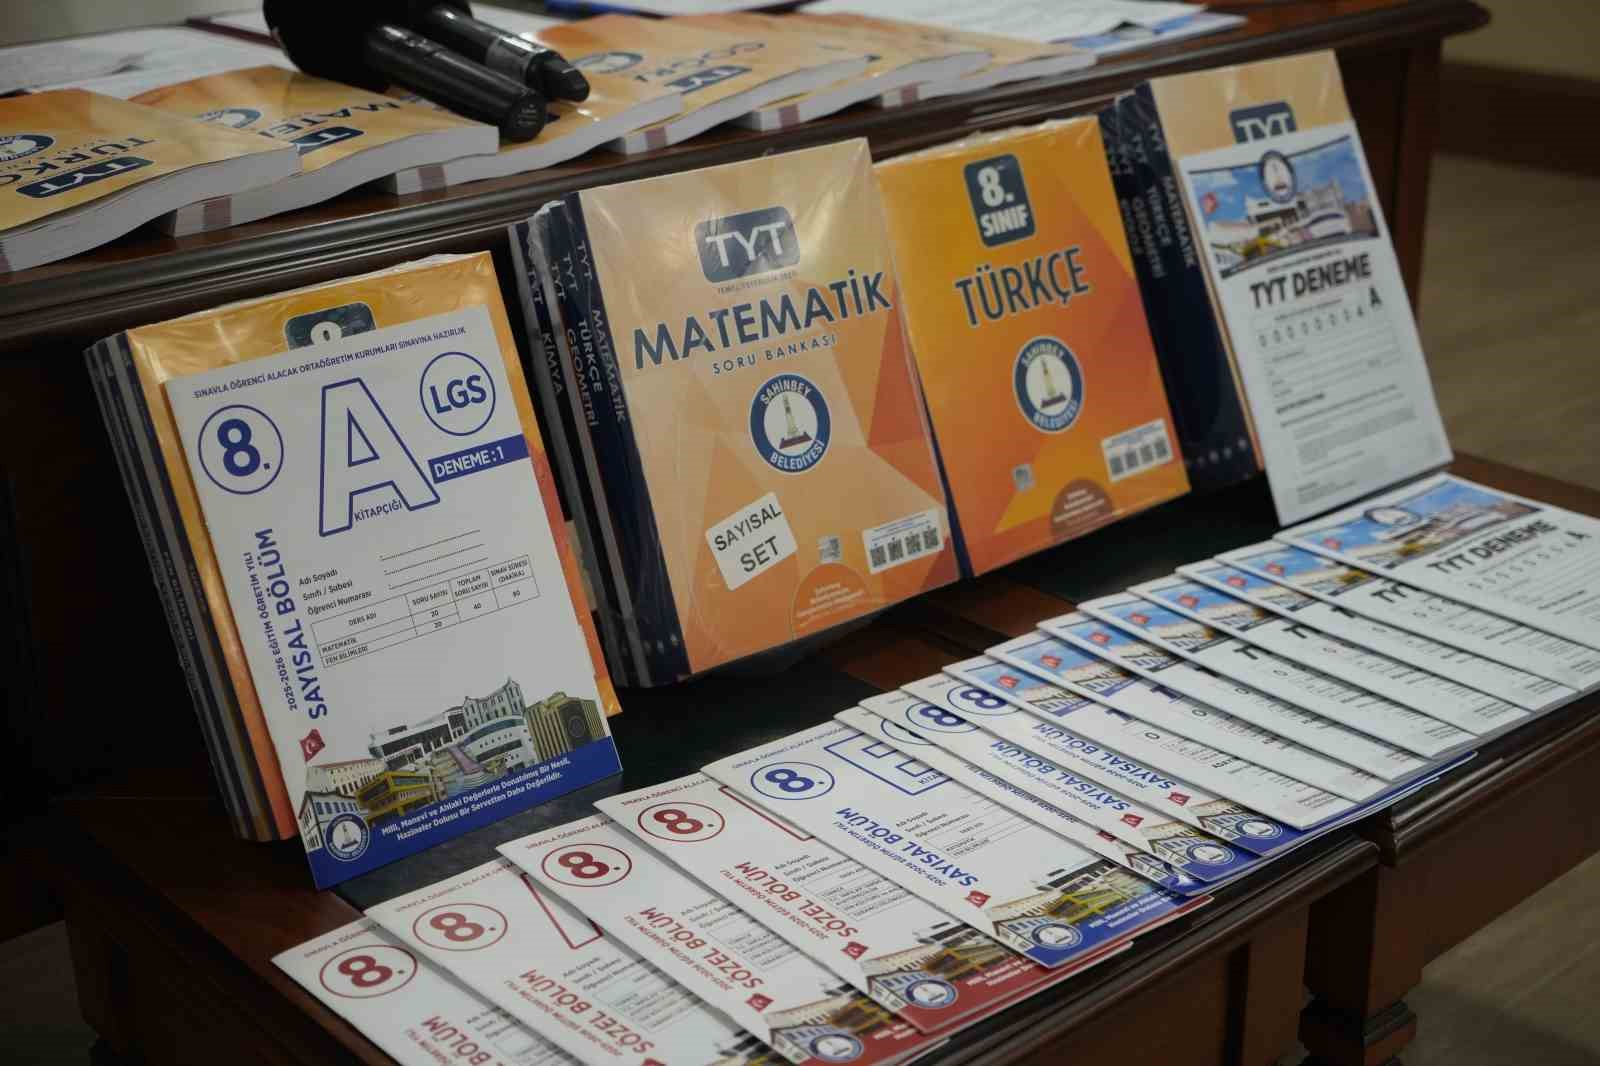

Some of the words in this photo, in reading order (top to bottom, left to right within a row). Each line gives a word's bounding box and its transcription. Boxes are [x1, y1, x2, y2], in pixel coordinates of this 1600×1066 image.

[40, 162, 139, 195] TYT
[977, 166, 1015, 208] 8.
[980, 204, 1029, 238] SINIF
[705, 221, 786, 268] TYT
[551, 262, 567, 300] TYT
[954, 247, 1089, 327] TÜRKÇE
[1249, 277, 1287, 309] TYT
[1292, 254, 1372, 298] DENEME
[1368, 285, 1383, 308] A
[528, 268, 543, 305] TYT
[542, 331, 563, 395] KİMYA
[563, 253, 579, 290] TYT
[577, 319, 603, 393] TÜRKÇE
[576, 239, 593, 281] TYT
[592, 309, 627, 424] MATEMATİK
[633, 269, 891, 370] MATEMATİK
[712, 351, 757, 375] SORU
[765, 334, 837, 361] BANKASI
[230, 374, 266, 389] ÖĞRENCİ
[267, 367, 299, 381] ALACAK
[430, 374, 487, 415] LGS
[217, 418, 271, 477] 8.
[319, 377, 440, 537] A
[714, 502, 782, 552] SAYISAL
[255, 528, 296, 616] BÖLÜM
[739, 535, 780, 573] SET
[273, 657, 298, 711] 2025-2026
[284, 618, 328, 719] SAYISAL
[990, 739, 1056, 774] BÖLÜM
[1032, 723, 1099, 755] BÖLÜM
[1056, 771, 1131, 811] SAYISAL
[1101, 751, 1177, 790] SAYISAL
[835, 807, 904, 844] BÖLÜM
[734, 861, 801, 902] BÖLÜM
[901, 841, 978, 887] SAYISAL
[639, 906, 707, 950] BÖLÜM
[798, 899, 858, 938] SÖZEL
[703, 947, 764, 989] SÖZEL
[519, 969, 593, 1014] BÖLÜM
[589, 1010, 655, 1054] SÖZEL
